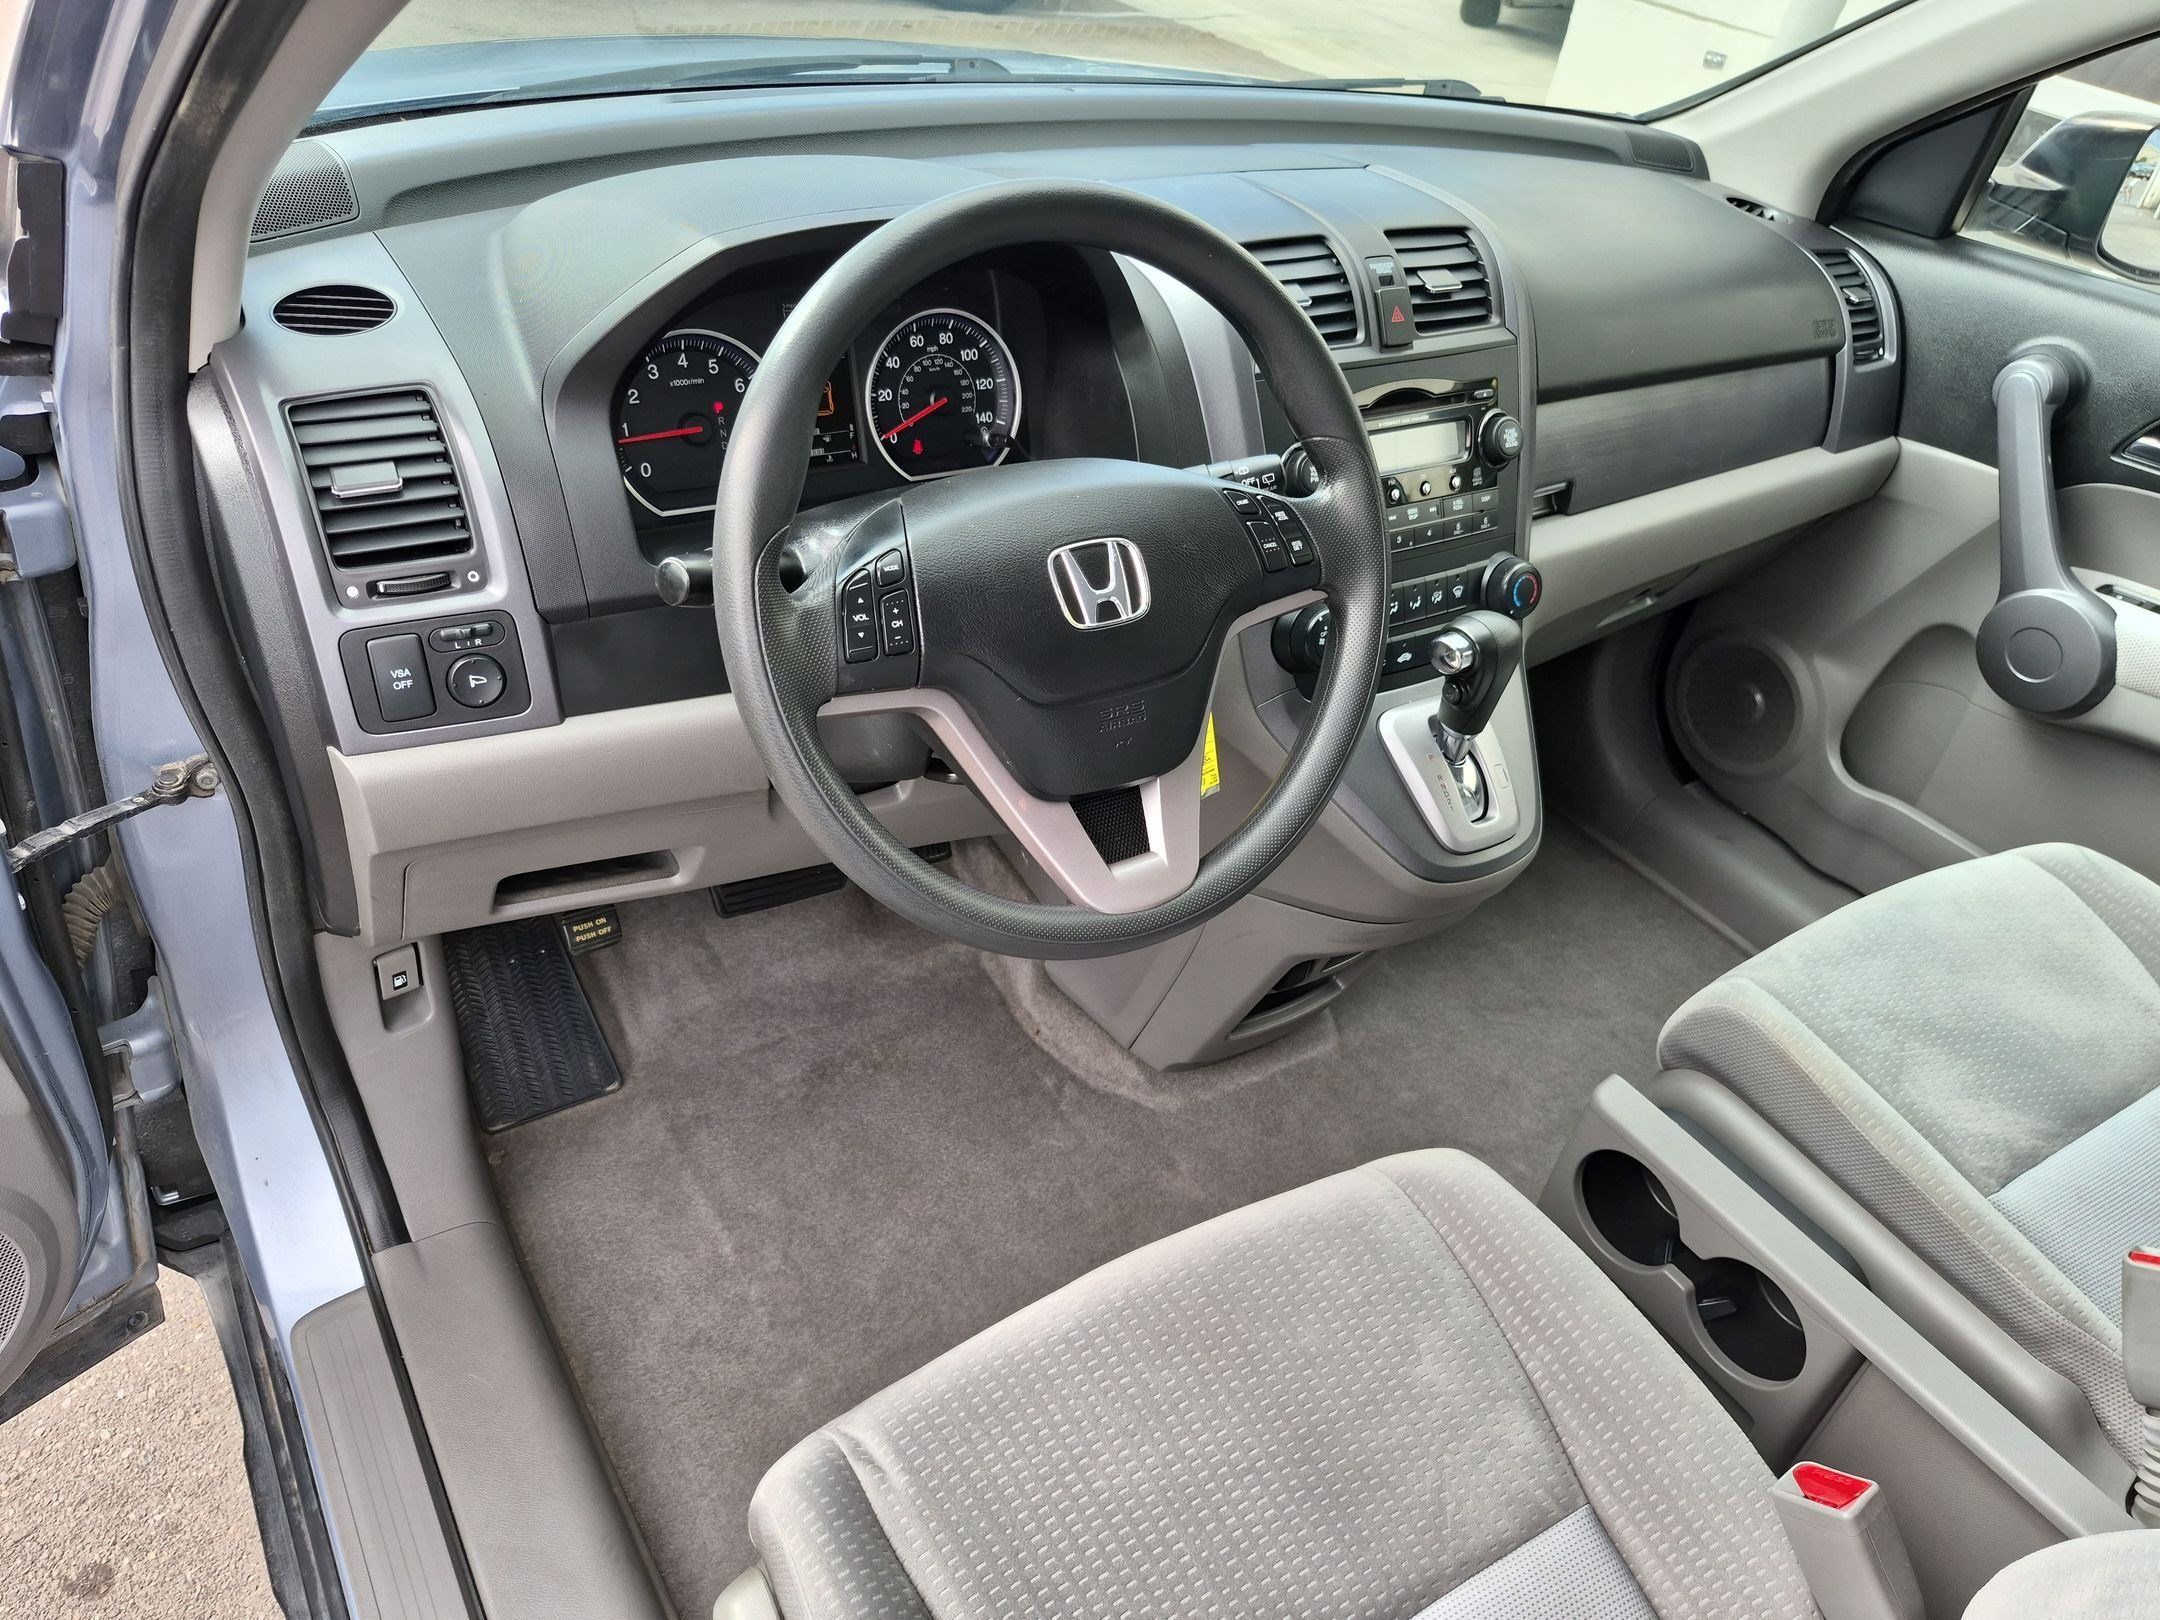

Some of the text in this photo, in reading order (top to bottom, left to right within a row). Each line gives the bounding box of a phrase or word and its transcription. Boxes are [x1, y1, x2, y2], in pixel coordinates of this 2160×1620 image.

[910, 335, 924, 348] 60
[939, 332, 953, 344] 80
[678, 352, 688, 368] 4
[960, 349, 978, 361] 100
[708, 359, 719, 374] 5
[886, 356, 900, 369] 40
[648, 364, 659, 380] 3
[734, 378, 746, 392] 6
[976, 378, 994, 390] 120
[628, 389, 640, 404] 2
[878, 389, 892, 402] 20
[976, 412, 994, 424] 140
[622, 422, 629, 437] 1
[640, 462, 652, 477] 0
[852, 613, 870, 622] VOL
[891, 620, 904, 628] CH
[475, 638, 482, 646] R
[390, 668, 412, 679] VSA
[392, 680, 413, 690] OFF
[572, 916, 607, 932] PUSH ON
[576, 926, 612, 942] PUSH OFF
